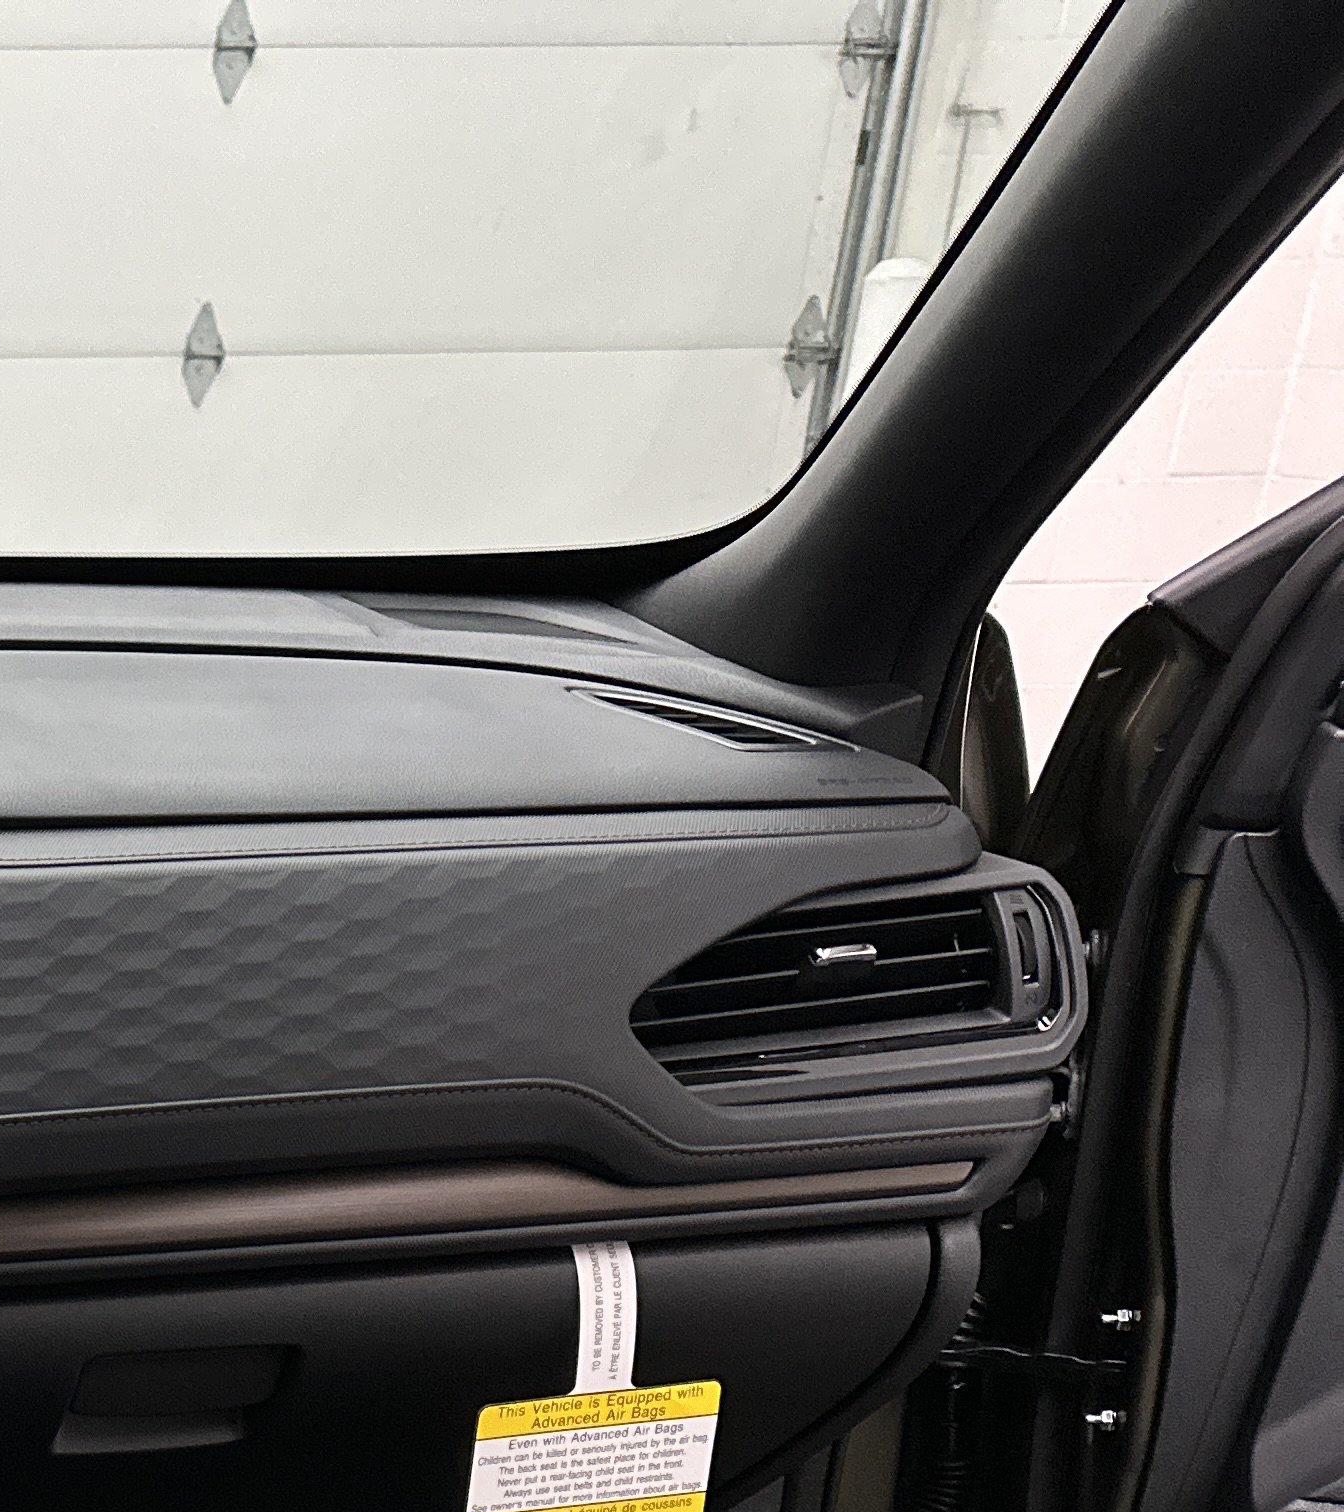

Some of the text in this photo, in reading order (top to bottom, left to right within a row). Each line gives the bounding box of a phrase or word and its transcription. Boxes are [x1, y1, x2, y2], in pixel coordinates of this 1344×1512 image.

[590, 1249, 602, 1293] CUSTOMER
[595, 1295, 603, 1306] BY
[614, 1291, 622, 1301] LE
[614, 1303, 622, 1319] PAR
[594, 1307, 603, 1346] REMOVED
[592, 1360, 601, 1372] TO
[499, 1385, 703, 1418] This Vehicle is Equipped with
[531, 1406, 666, 1429] Advanced Air Bags
[509, 1424, 683, 1450] Even with Advanced Air Bags
[478, 1455, 511, 1466] Children
[514, 1453, 529, 1461] can
[582, 1443, 616, 1454] seriously
[620, 1441, 647, 1451] injured
[651, 1439, 660, 1448] by
[679, 1436, 689, 1444] air
[499, 1466, 514, 1475] The
[518, 1464, 537, 1473] back
[540, 1462, 557, 1471] seat
[587, 1455, 611, 1465] safest
[614, 1454, 635, 1463] place
[498, 1479, 521, 1487] Never
[525, 1476, 537, 1486] put
[550, 1471, 592, 1480] rear-facing
[596, 1467, 614, 1476] child
[617, 1465, 634, 1473] seat
[472, 1505, 487, 1512] See
[526, 1496, 555, 1506] manual
[559, 1495, 569, 1503] for
[573, 1494, 593, 1502] more
[596, 1488, 640, 1499] information
[643, 1485, 665, 1494] about
[504, 1489, 532, 1498] Always
[554, 1483, 571, 1493] seat
[574, 1482, 592, 1490] belts
[596, 1480, 611, 1488] and
[615, 1477, 633, 1485] child
[622, 1504, 636, 1512] de
[642, 1498, 692, 1511] coussins
